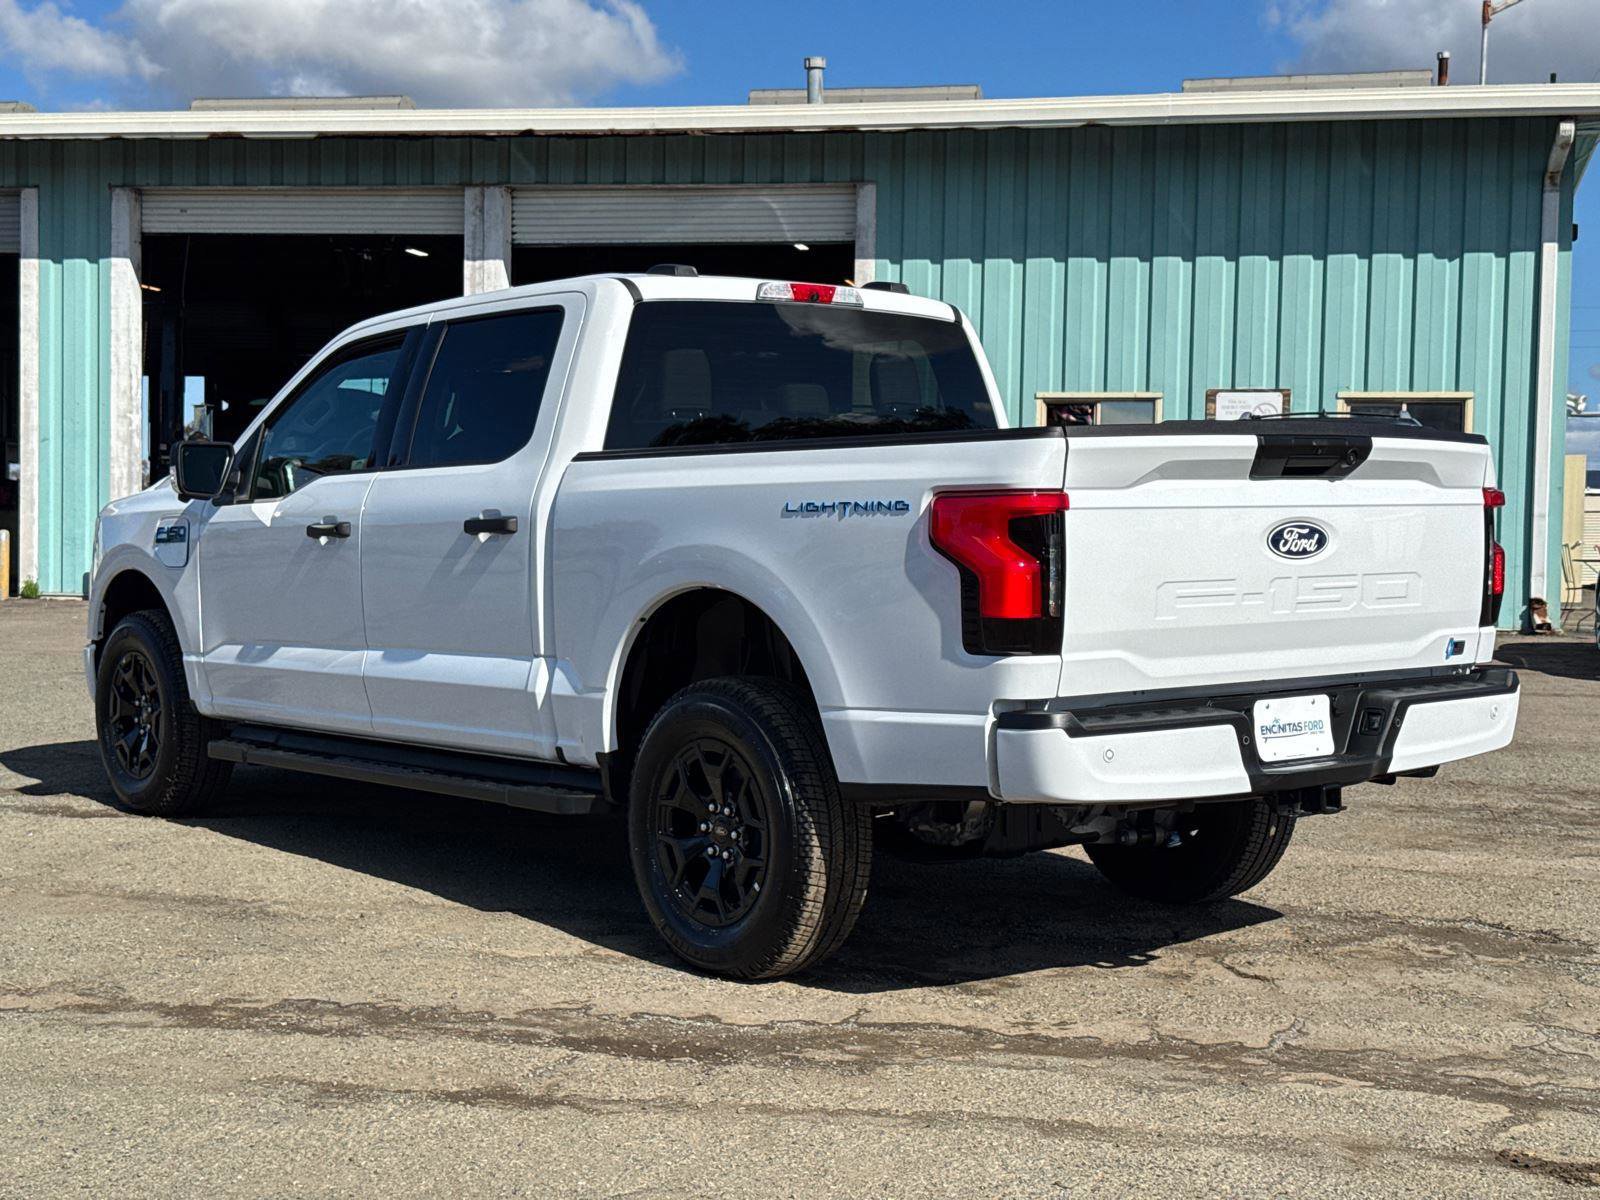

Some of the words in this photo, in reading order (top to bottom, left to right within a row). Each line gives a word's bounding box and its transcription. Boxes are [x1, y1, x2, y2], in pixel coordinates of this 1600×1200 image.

[784, 500, 910, 516] LIGHTNING
[1279, 527, 1319, 552] Ford
[1154, 571, 1422, 620] F-150
[1303, 719, 1324, 731] FORD
